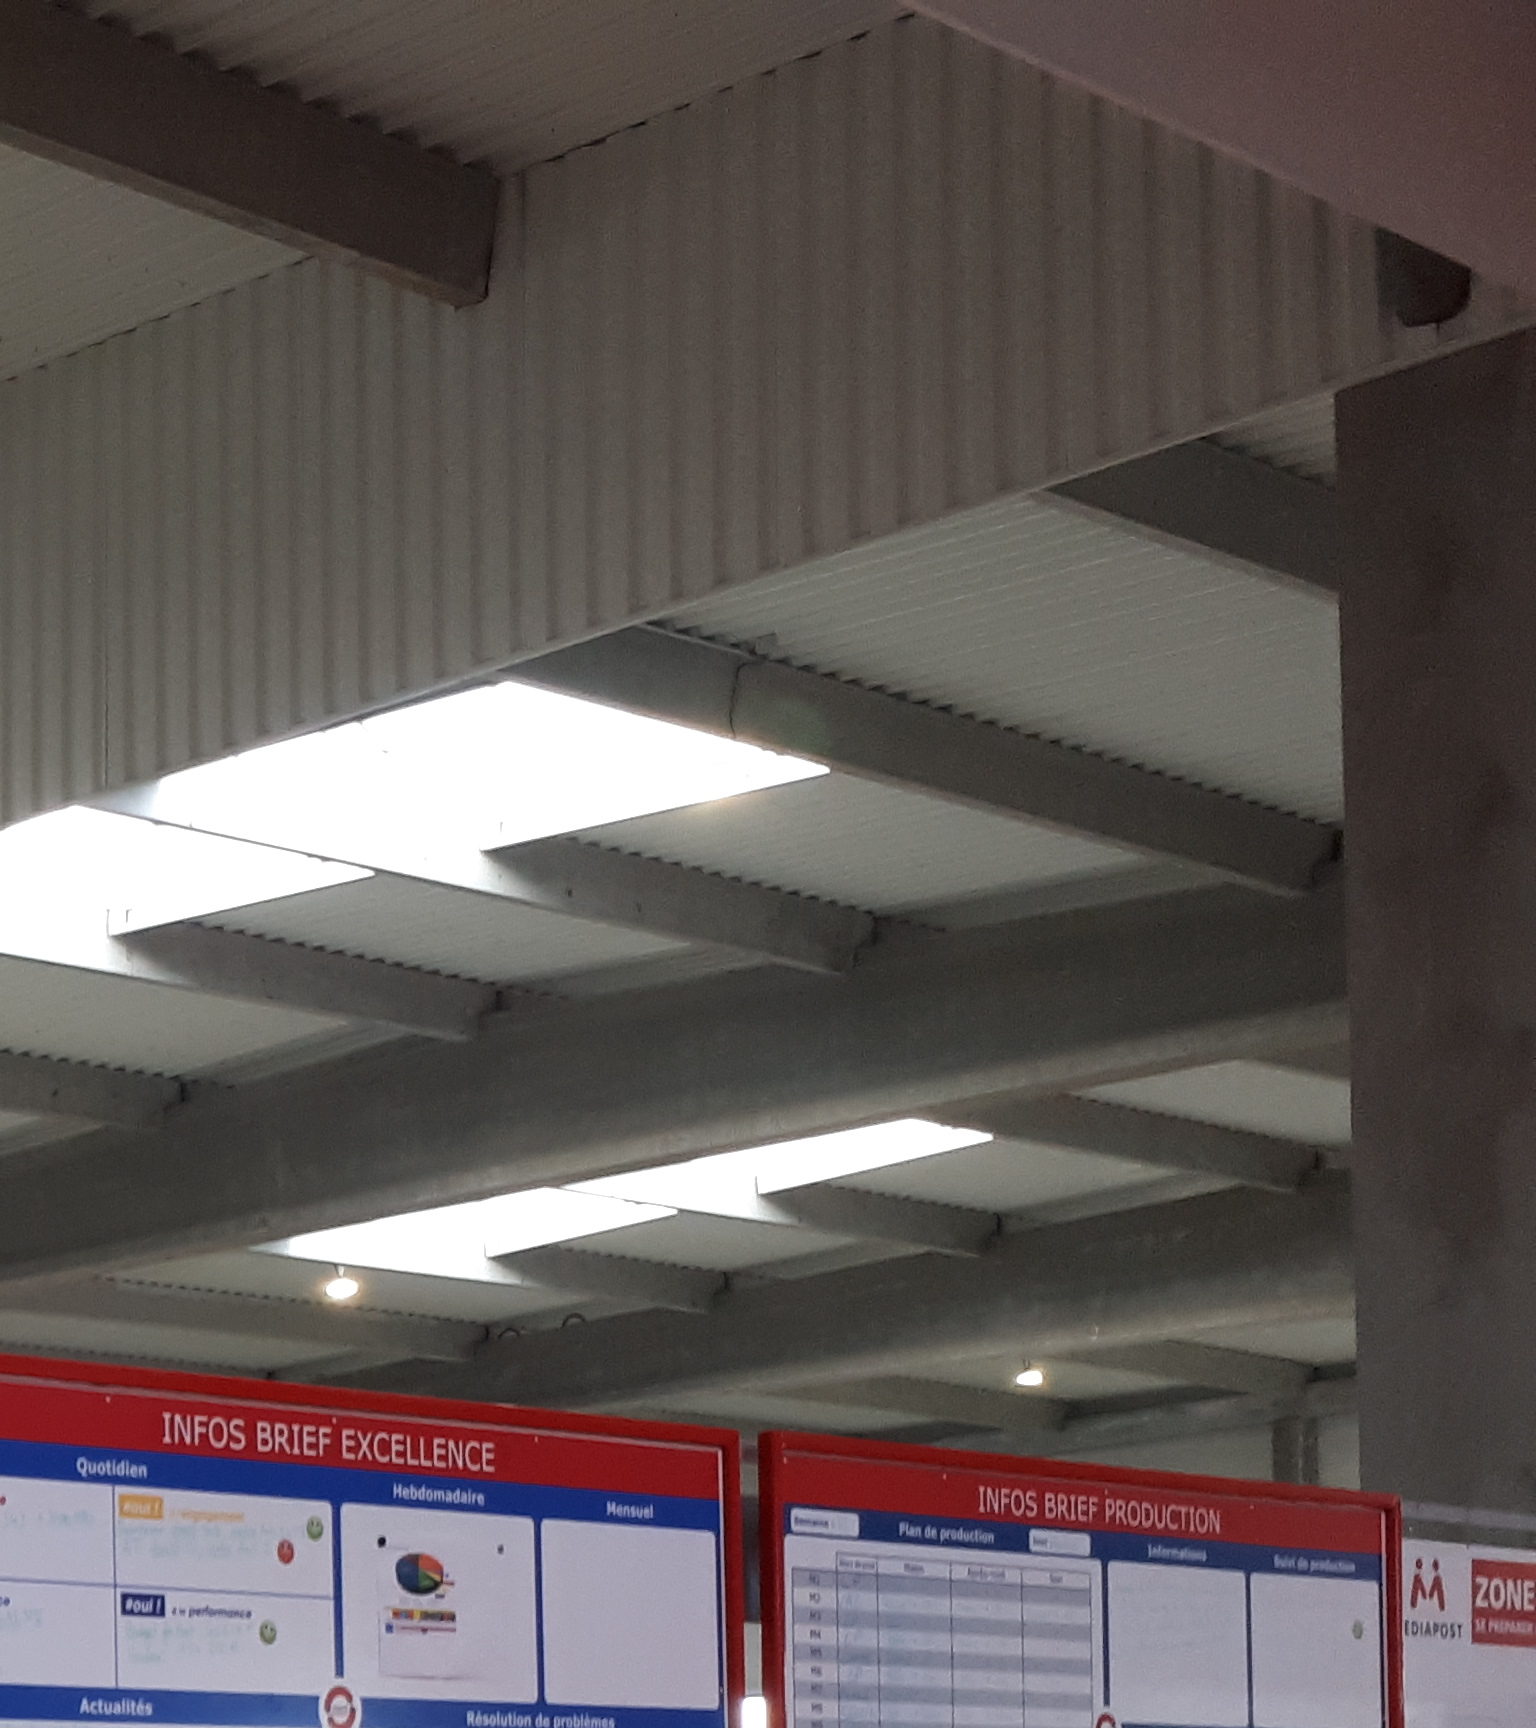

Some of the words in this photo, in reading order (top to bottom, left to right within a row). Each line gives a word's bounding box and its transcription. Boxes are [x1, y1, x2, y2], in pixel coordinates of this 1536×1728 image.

[161, 1411, 247, 1452] INFOS
[256, 1419, 332, 1458] BRIEF
[341, 1428, 496, 1474] EXCELLENCE
[76, 1457, 148, 1480] Quotidien
[392, 1483, 486, 1506] Hebdomadaire
[606, 1501, 654, 1519] Mensuel
[978, 1485, 1037, 1518] INFOS
[1044, 1491, 1099, 1524] BRIEF
[1105, 1496, 1222, 1535] PRODUCTION
[898, 1521, 920, 1539] Plan
[923, 1524, 939, 1541] de
[939, 1525, 995, 1546] production
[1146, 1543, 1207, 1563] Informations
[1473, 1573, 1535, 1611] ZONE
[124, 1596, 154, 1614] #oui
[1404, 1619, 1462, 1640] EDIAPOST
[79, 1697, 153, 1717] Actualités
